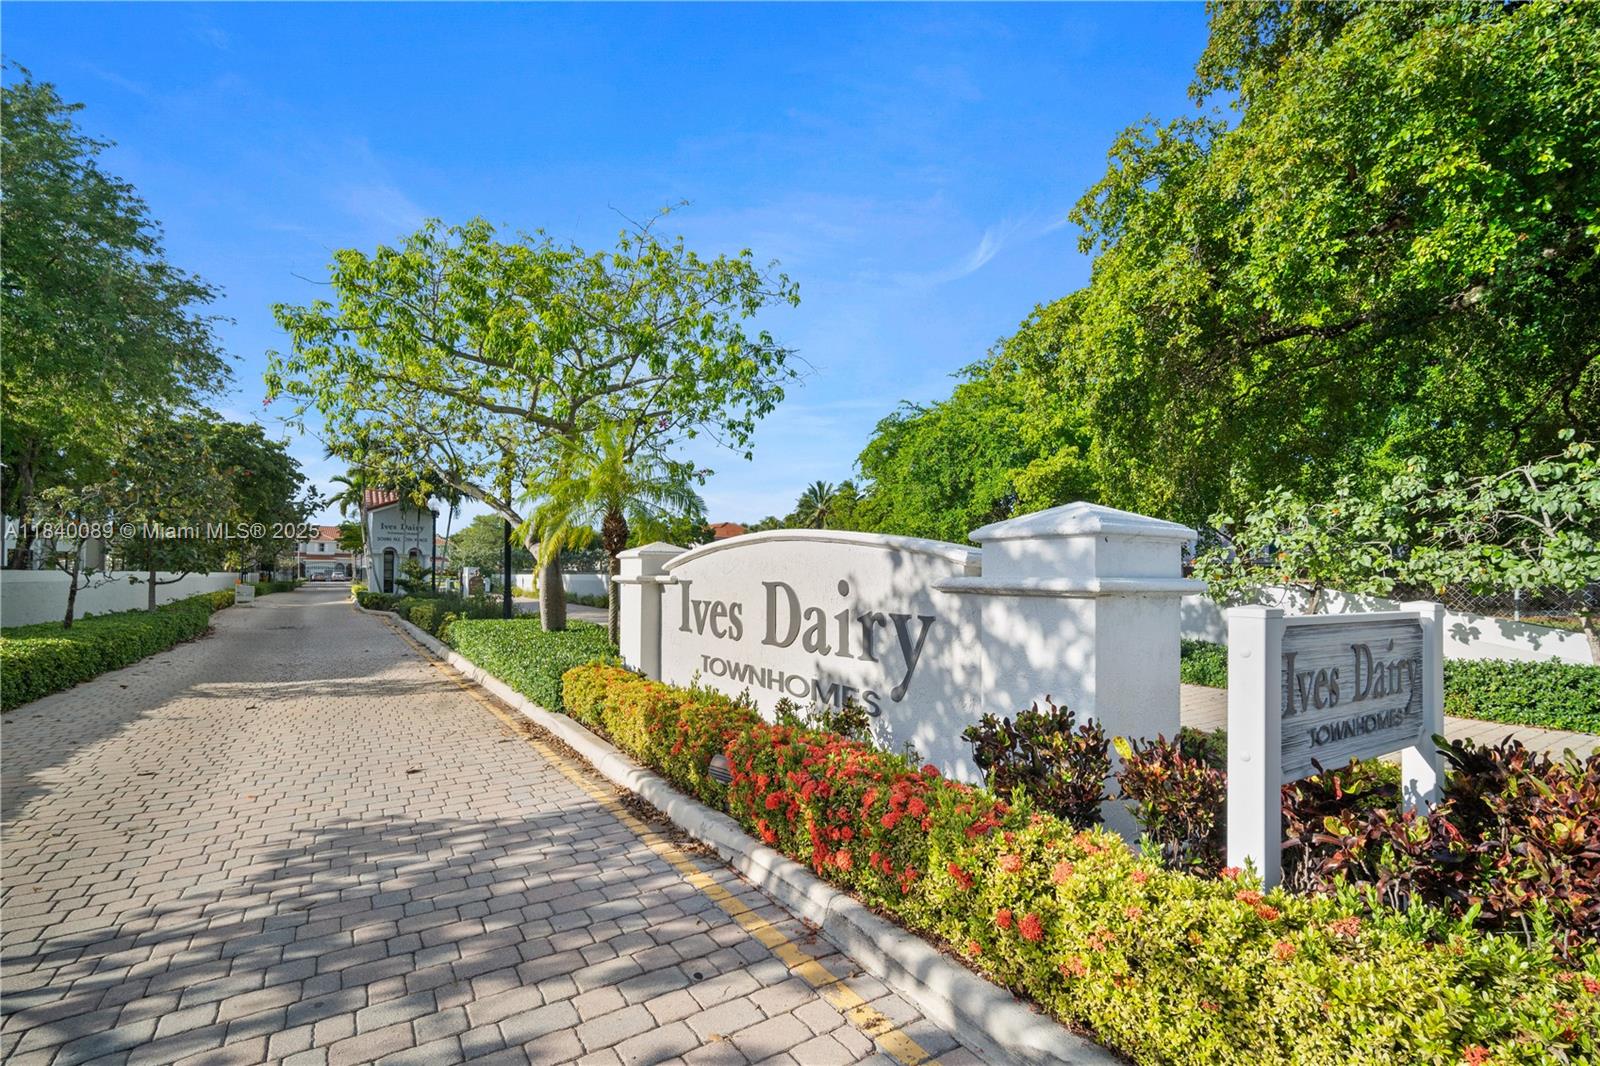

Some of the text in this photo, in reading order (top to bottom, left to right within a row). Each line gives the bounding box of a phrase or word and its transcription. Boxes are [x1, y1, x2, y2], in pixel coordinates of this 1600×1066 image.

[380, 522, 397, 530] Ives
[678, 579, 936, 703] Ives Dairy
[700, 654, 882, 717] TOWNHOMES
[1282, 638, 1417, 719] Ives Dairy
[1307, 710, 1405, 748] TOWNHOMES
